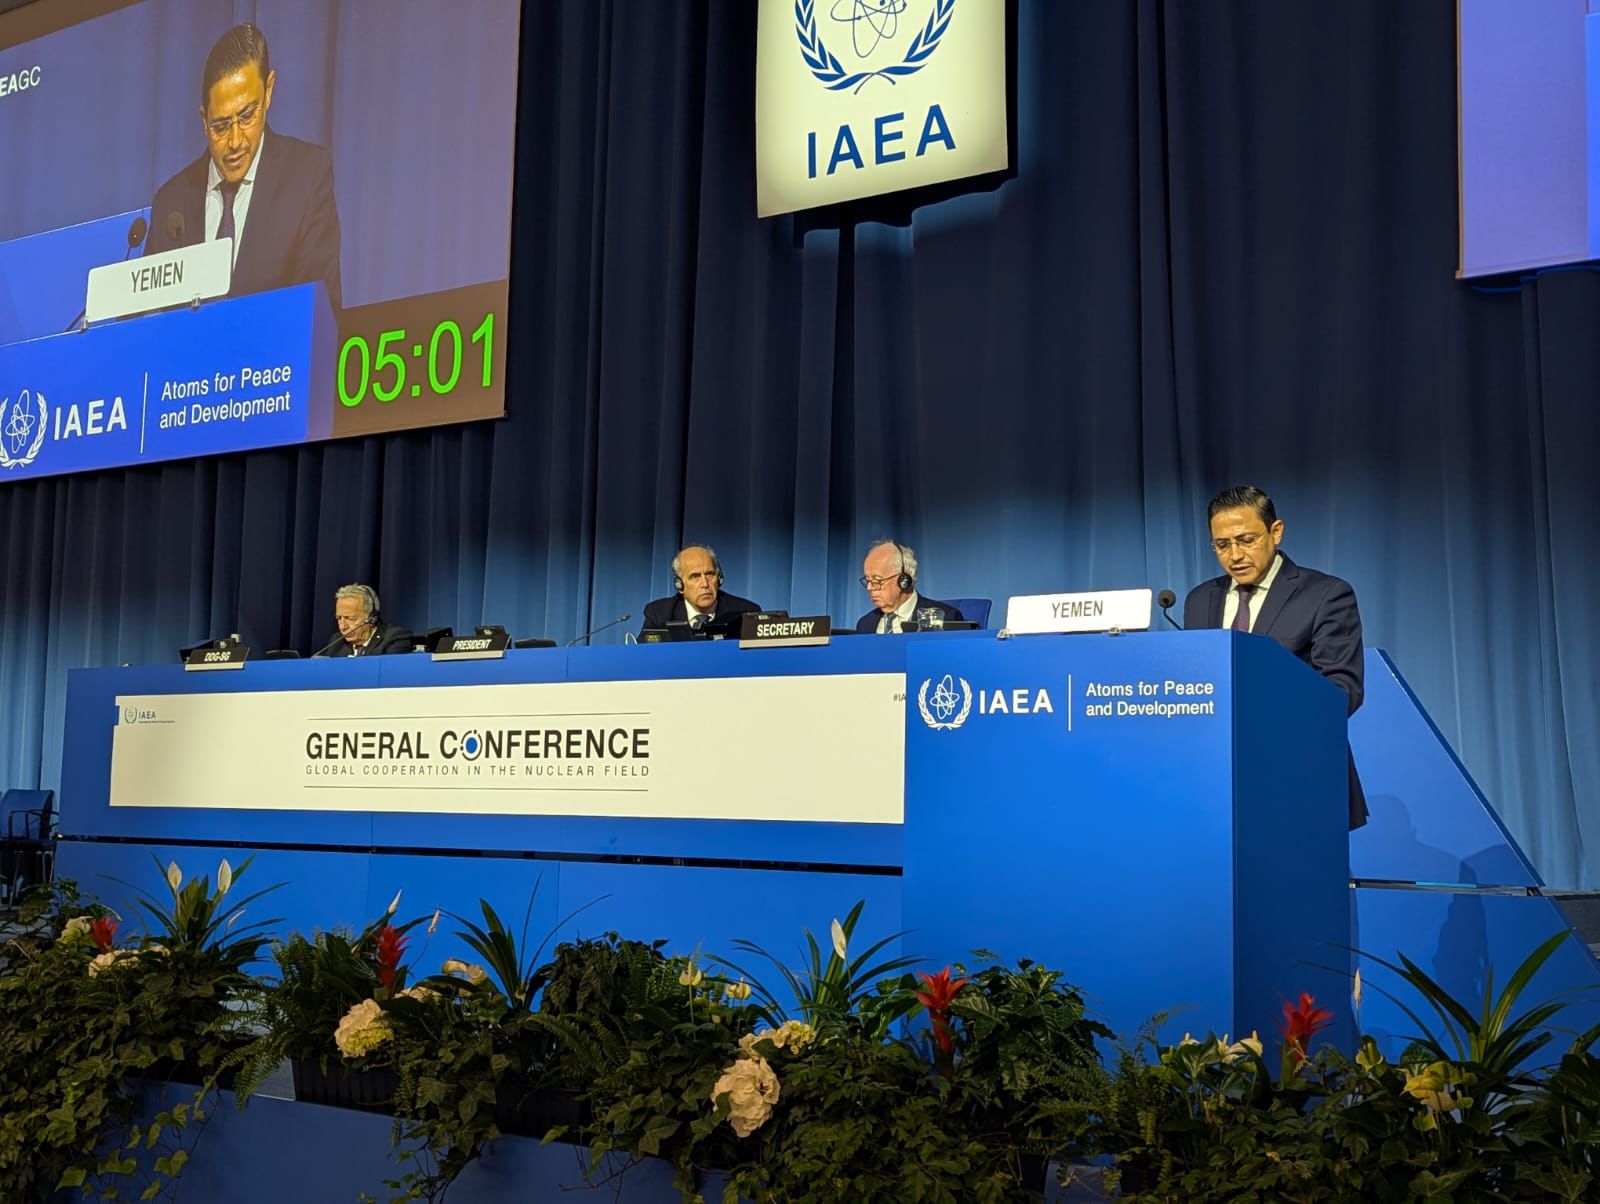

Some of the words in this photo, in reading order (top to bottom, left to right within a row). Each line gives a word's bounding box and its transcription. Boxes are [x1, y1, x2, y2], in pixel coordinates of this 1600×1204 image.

[0, 66, 41, 96] EAGC
[808, 104, 956, 179] IAEA
[131, 260, 184, 293] YEMEN
[337, 313, 495, 407] 05:01
[161, 378, 209, 401] Atoms
[214, 372, 236, 392] for
[241, 365, 292, 388] Peace
[53, 396, 127, 441] IAEA
[160, 406, 187, 429] and
[191, 391, 291, 425] Development
[1050, 600, 1104, 619] YEMEN
[756, 621, 815, 637] SECRETARY
[204, 651, 231, 662] DDG-SG
[452, 639, 493, 651] PRESIDENT
[979, 688, 1054, 715] IAEA
[1086, 682, 1133, 697] Atoms
[1138, 680, 1160, 696] for
[1164, 681, 1214, 695] Peace
[138, 711, 156, 719] IAEA
[1086, 701, 1112, 716] and
[1116, 700, 1215, 718] Development
[306, 731, 430, 760] GENERAL
[439, 728, 650, 761] CONFERENCE
[305, 764, 356, 775] GLOBAL
[363, 765, 459, 775] COOPERATION
[467, 765, 481, 775] IN
[490, 765, 516, 775] THE
[525, 765, 595, 776] NUCLEAR
[604, 765, 649, 776] FIELD
